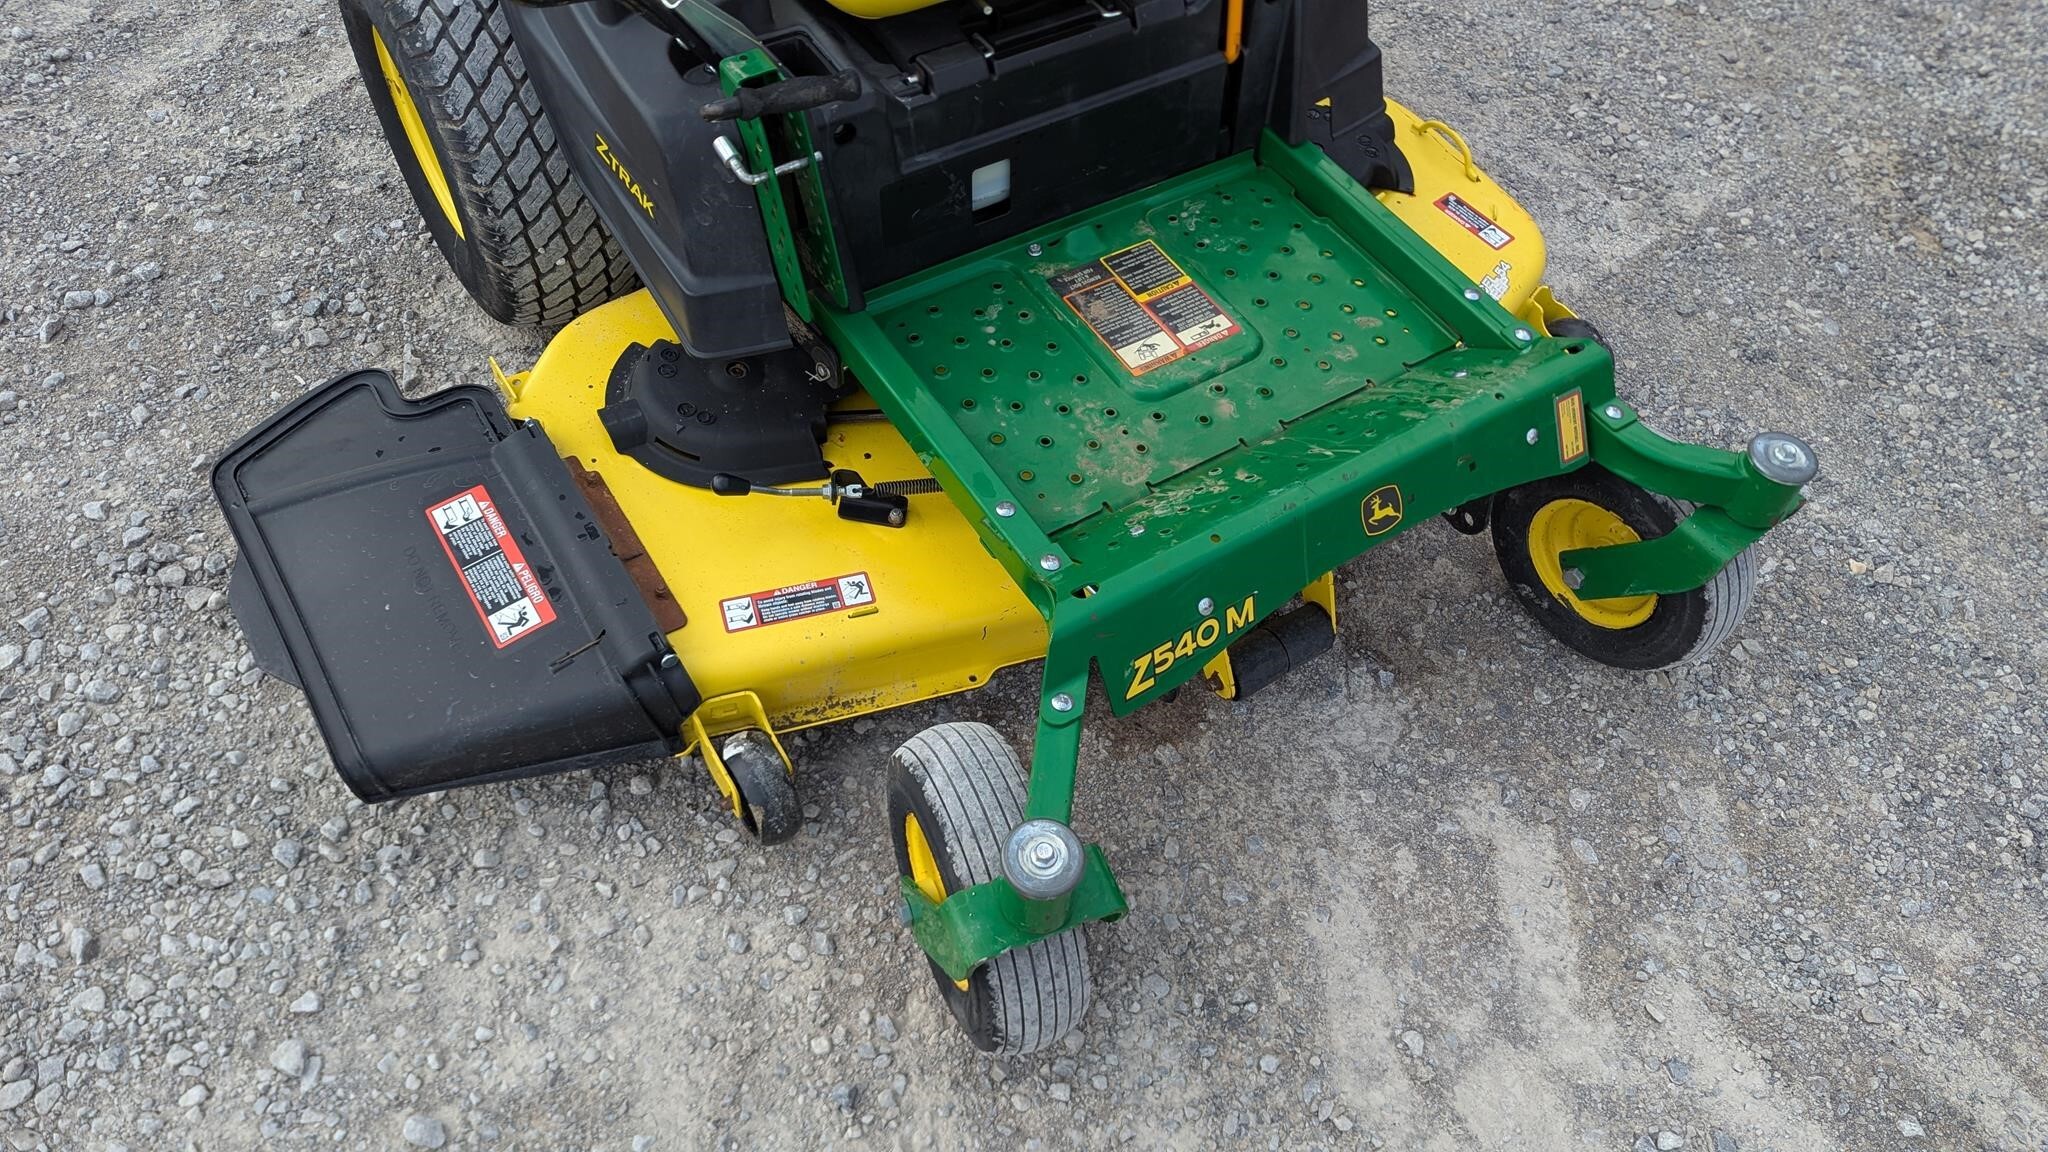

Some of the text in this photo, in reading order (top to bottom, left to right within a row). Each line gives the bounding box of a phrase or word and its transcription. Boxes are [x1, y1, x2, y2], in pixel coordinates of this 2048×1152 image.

[595, 132, 655, 219] ZTRAK
[1147, 282, 1175, 298] CAUTION
[1196, 331, 1224, 347] DANGER
[1141, 355, 1170, 371] WARNING
[484, 507, 507, 538] DANGER
[518, 569, 545, 604] PELIGRO
[780, 582, 818, 595] DANGER
[1125, 595, 1255, 700] Z540 M
